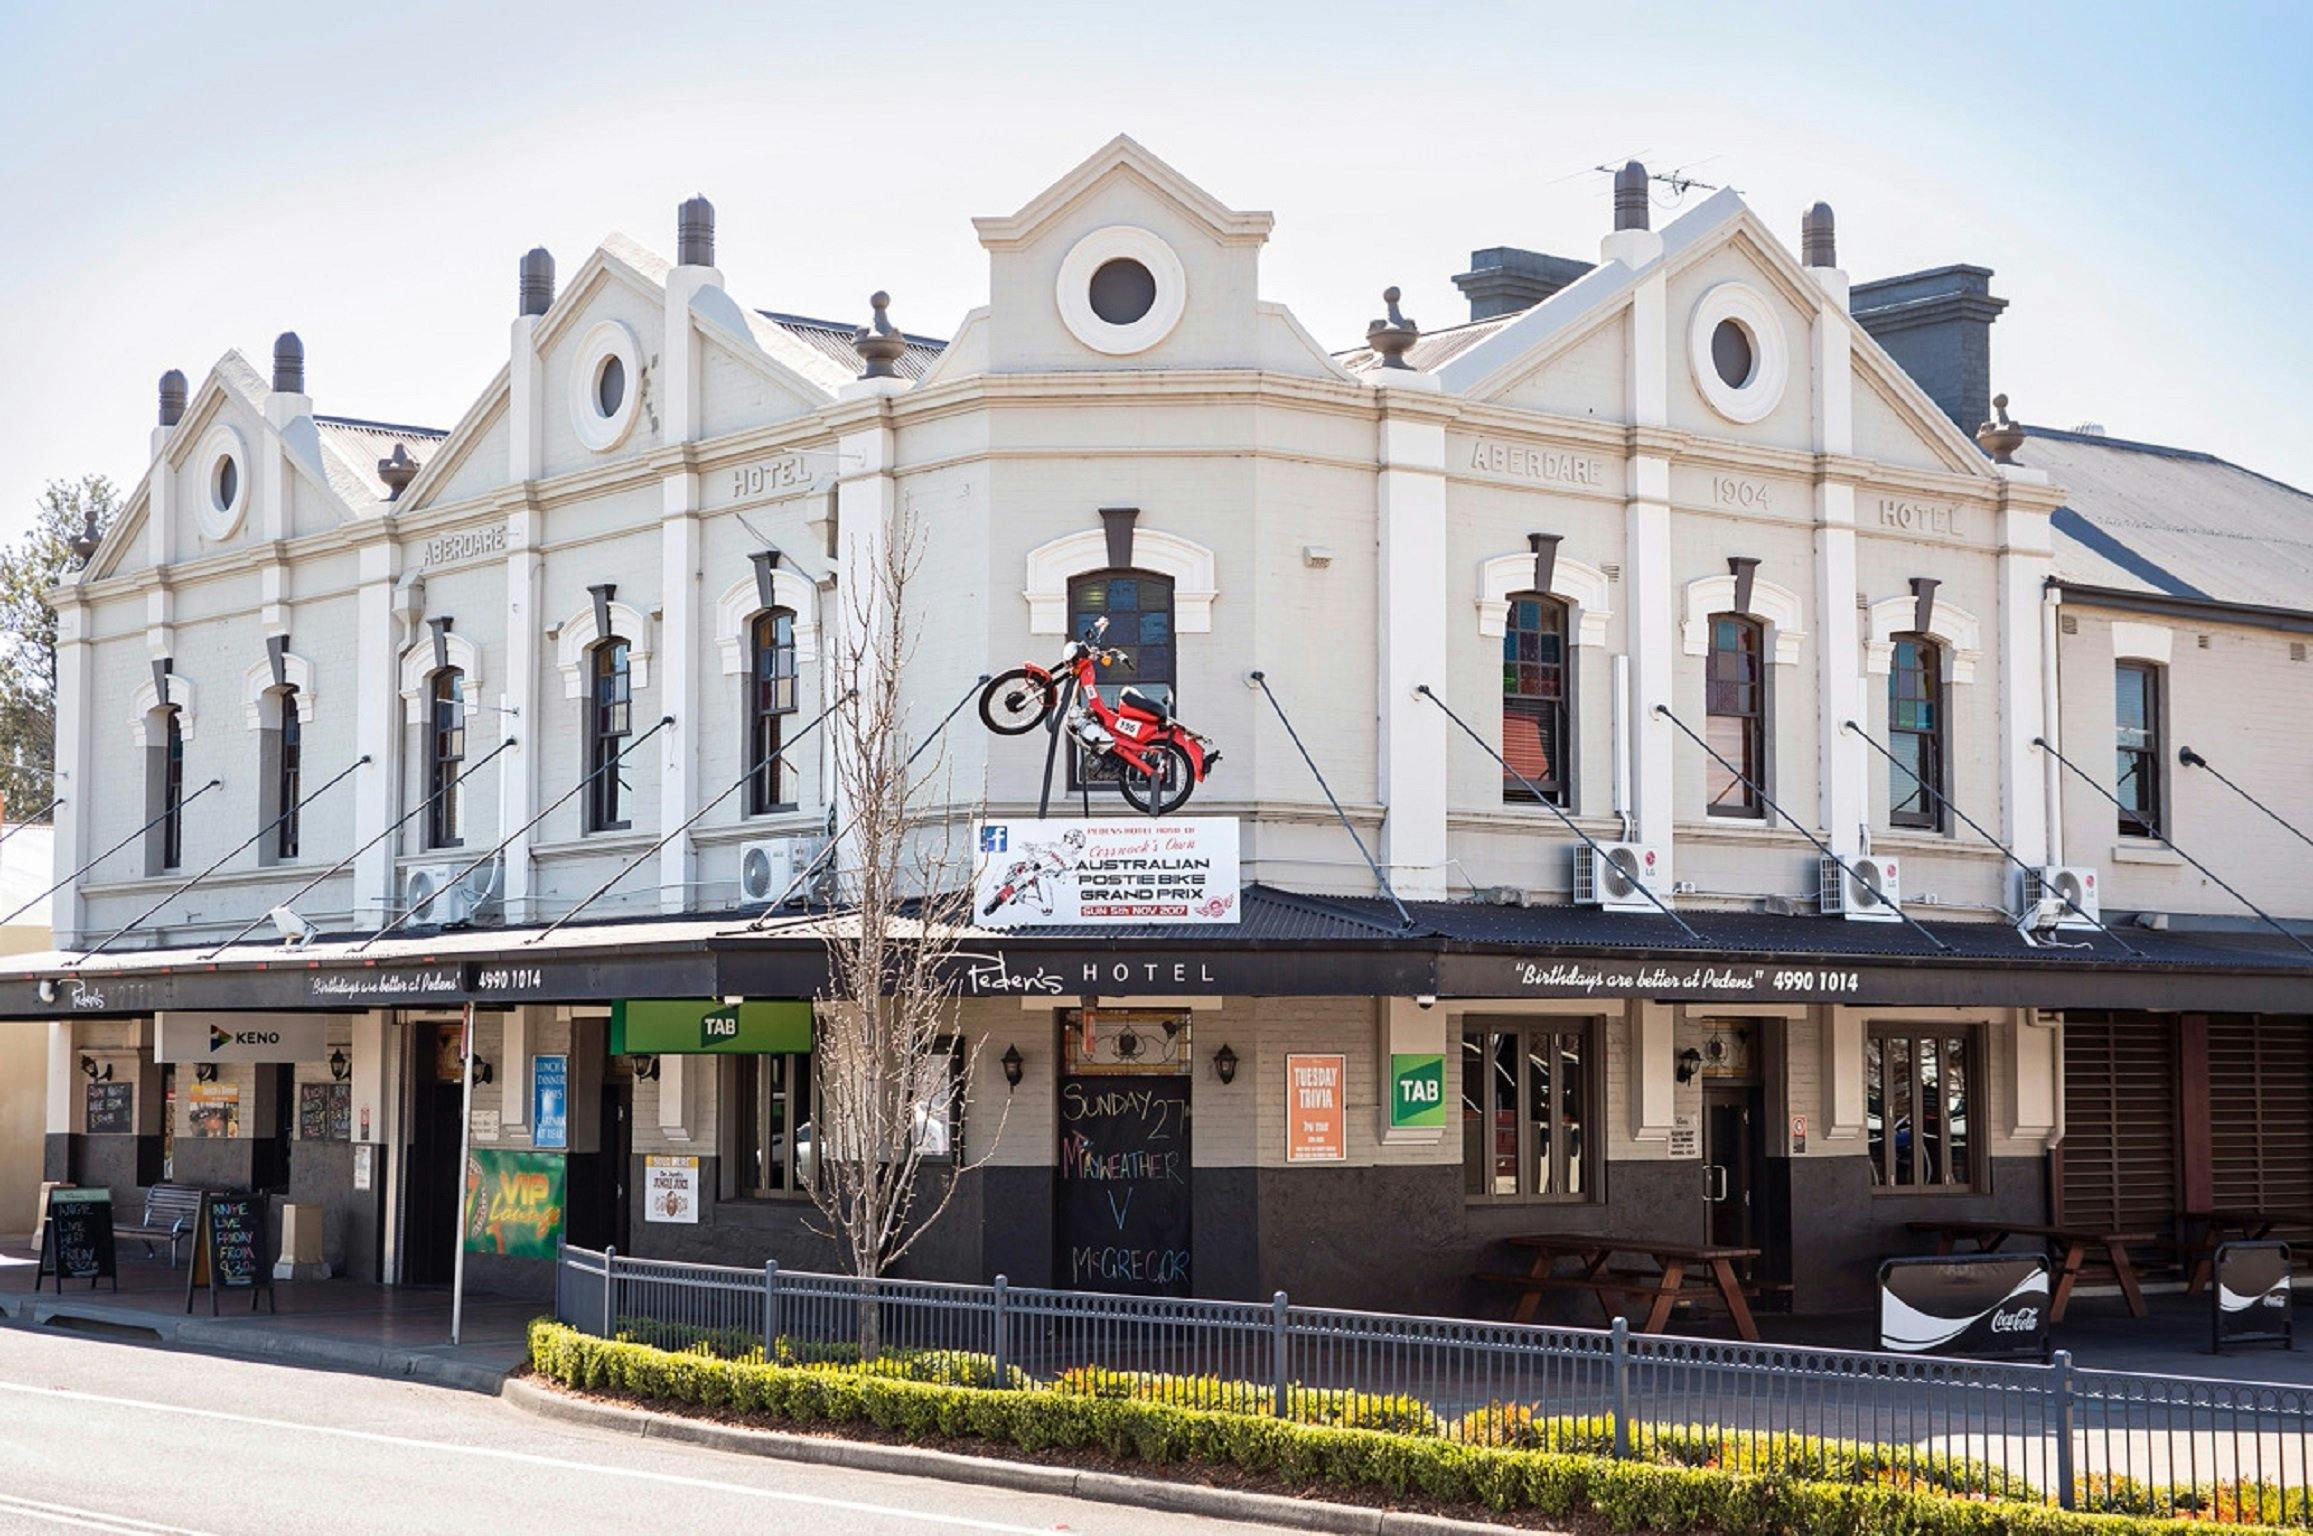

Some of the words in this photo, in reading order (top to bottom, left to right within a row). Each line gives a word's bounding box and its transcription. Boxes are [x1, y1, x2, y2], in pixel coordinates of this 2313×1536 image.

[1471, 442, 1602, 486] ABERDARE
[732, 458, 812, 498] HOTEL
[1714, 476, 1773, 509] 1904
[1879, 500, 1964, 537] HOTEL
[422, 525, 506, 566] ABERDARE
[1075, 858, 1210, 870] AUSTRALIAN
[1078, 875, 1157, 885] POSTIE
[1158, 875, 1206, 885] BIKE
[1080, 889, 1153, 900] GRAND
[1157, 889, 1203, 900] PRIX
[1081, 905, 1107, 916] SUN
[1133, 905, 1156, 916] NOV
[379, 975, 407, 993] better
[478, 970, 508, 988] 4990
[512, 969, 541, 988] 1014
[942, 950, 1063, 995] Peden's
[1083, 963, 1214, 982] HOTEL
[1606, 974, 1633, 988] are
[1636, 968, 1680, 989] better
[1682, 969, 1700, 988] at
[1773, 971, 1814, 991] 4990
[1819, 972, 1859, 992] 1014
[236, 1029, 280, 1044] KENO
[705, 1018, 736, 1035] TAB
[1294, 1067, 1338, 1087] TUESDAY
[1063, 1083, 1152, 1120] SUNDAY
[1299, 1088, 1333, 1109] TRIVIA
[1400, 1079, 1439, 1102] TAB
[500, 1171, 549, 1206] VIP
[489, 1193, 560, 1238] Lounge
[1107, 1186, 1134, 1230] V
[219, 1246, 256, 1260] FROM
